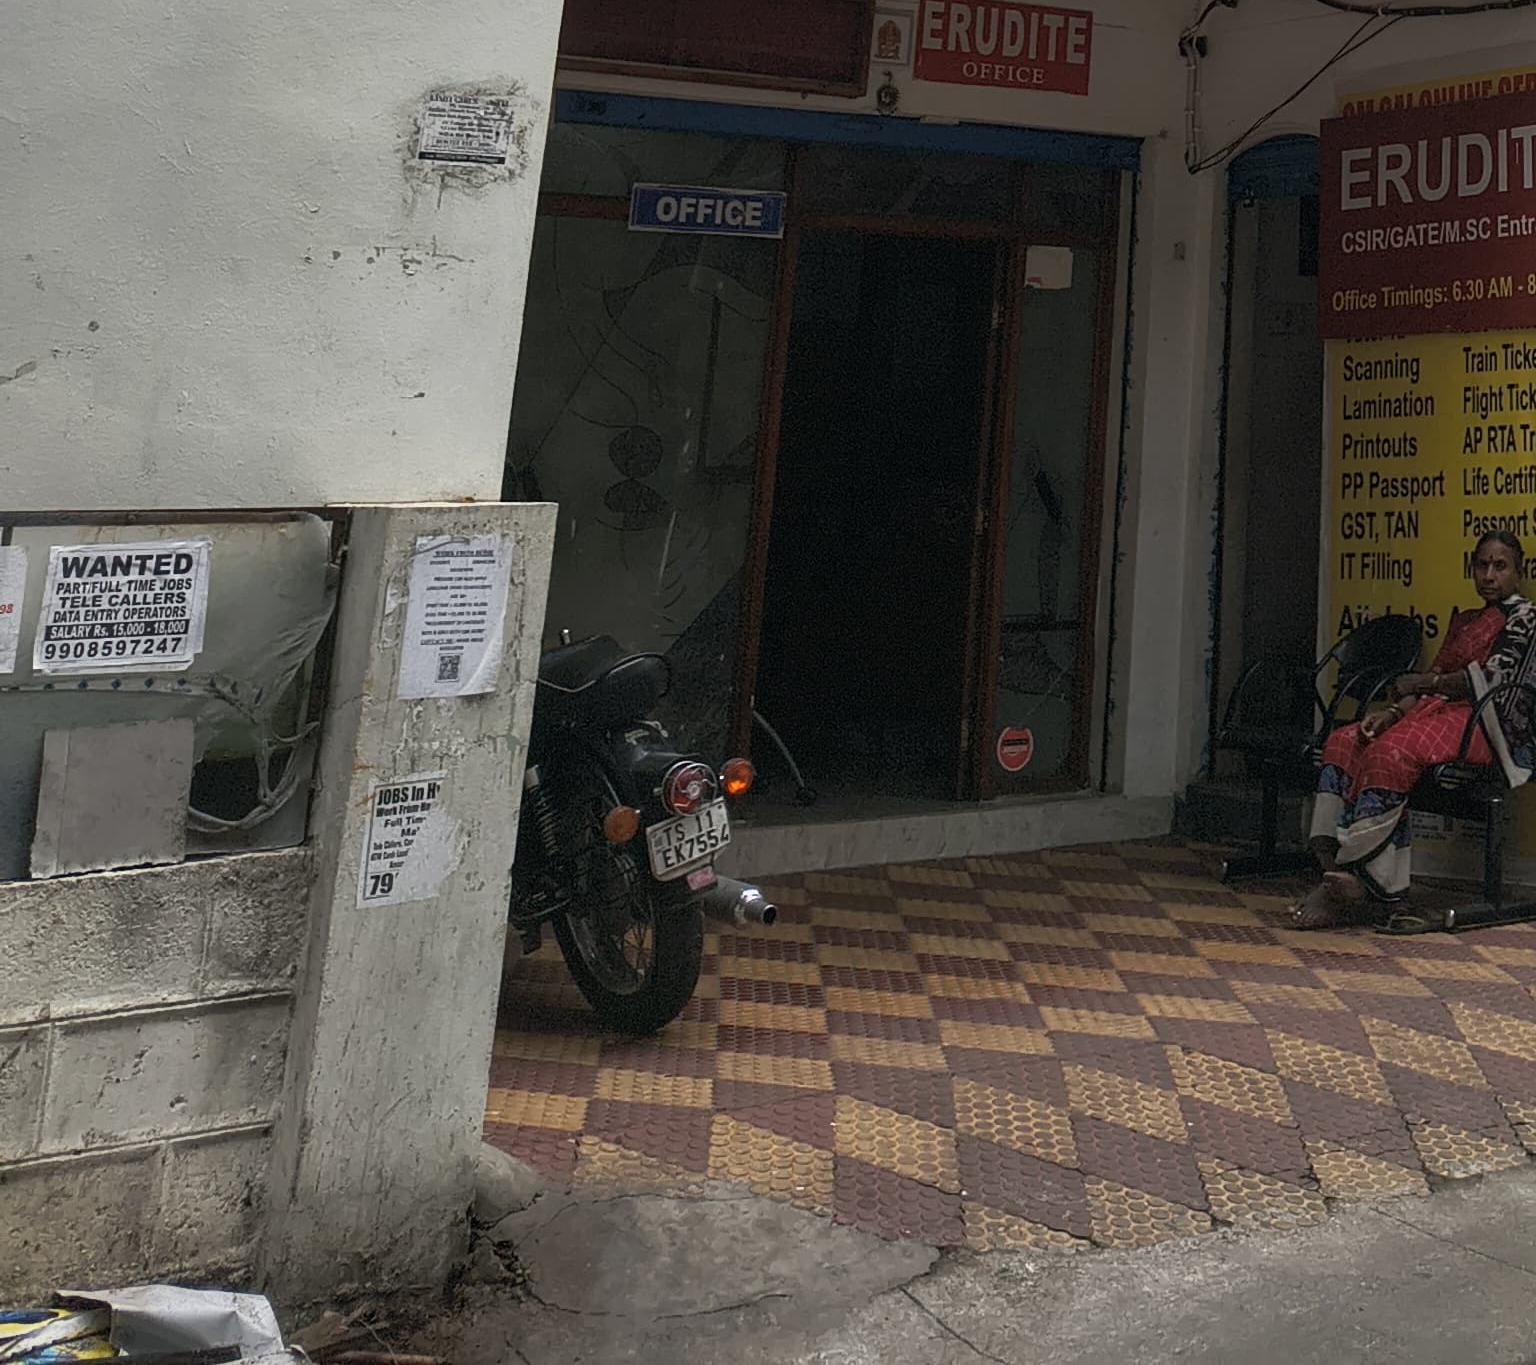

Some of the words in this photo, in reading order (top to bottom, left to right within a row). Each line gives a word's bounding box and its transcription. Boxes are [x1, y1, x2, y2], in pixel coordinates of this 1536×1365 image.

[922, 0, 1090, 64] ERUDITE
[962, 60, 1045, 85] OFFICE
[655, 195, 763, 227] OFFICE
[1342, 218, 1490, 253] CSIR/GATE/M.SC
[1332, 290, 1377, 311] Office
[1381, 284, 1448, 308] Timings:
[1453, 278, 1483, 301] 6.30
[1487, 276, 1513, 298] AM
[1343, 354, 1420, 384] Scanning
[1462, 346, 1498, 374] Train
[1343, 391, 1435, 420] Lamination
[1463, 386, 1503, 419] Flight
[1342, 432, 1418, 460] Printouts
[1462, 427, 1483, 455] AP
[1487, 425, 1516, 453] RTA
[1341, 472, 1364, 499] PP
[1369, 470, 1445, 503] Passport
[1463, 468, 1489, 496] Life
[1341, 513, 1379, 543] GST,
[1384, 511, 1419, 538] TAN
[62, 553, 193, 578] WANTED
[1340, 553, 1356, 580] IT
[1360, 551, 1413, 586] Filling
[56, 581, 122, 595] PART/FULL
[127, 580, 155, 592] TIME
[160, 578, 192, 590] JOBS
[59, 594, 102, 609] TELE
[108, 592, 186, 607] CALLERS
[53, 610, 81, 623] DATA
[84, 608, 120, 622] ENTRY
[123, 606, 186, 620] OPERATORS
[50, 625, 91, 639] SALARY
[93, 625, 109, 636] Rs.
[44, 637, 182, 660] 9908597247
[377, 787, 409, 805] JOBS
[411, 785, 424, 801] In
[384, 818, 402, 828] Full
[663, 823, 685, 845] TS
[696, 810, 713, 832] 11
[663, 824, 728, 867] EK7554
[370, 872, 399, 895] 79
